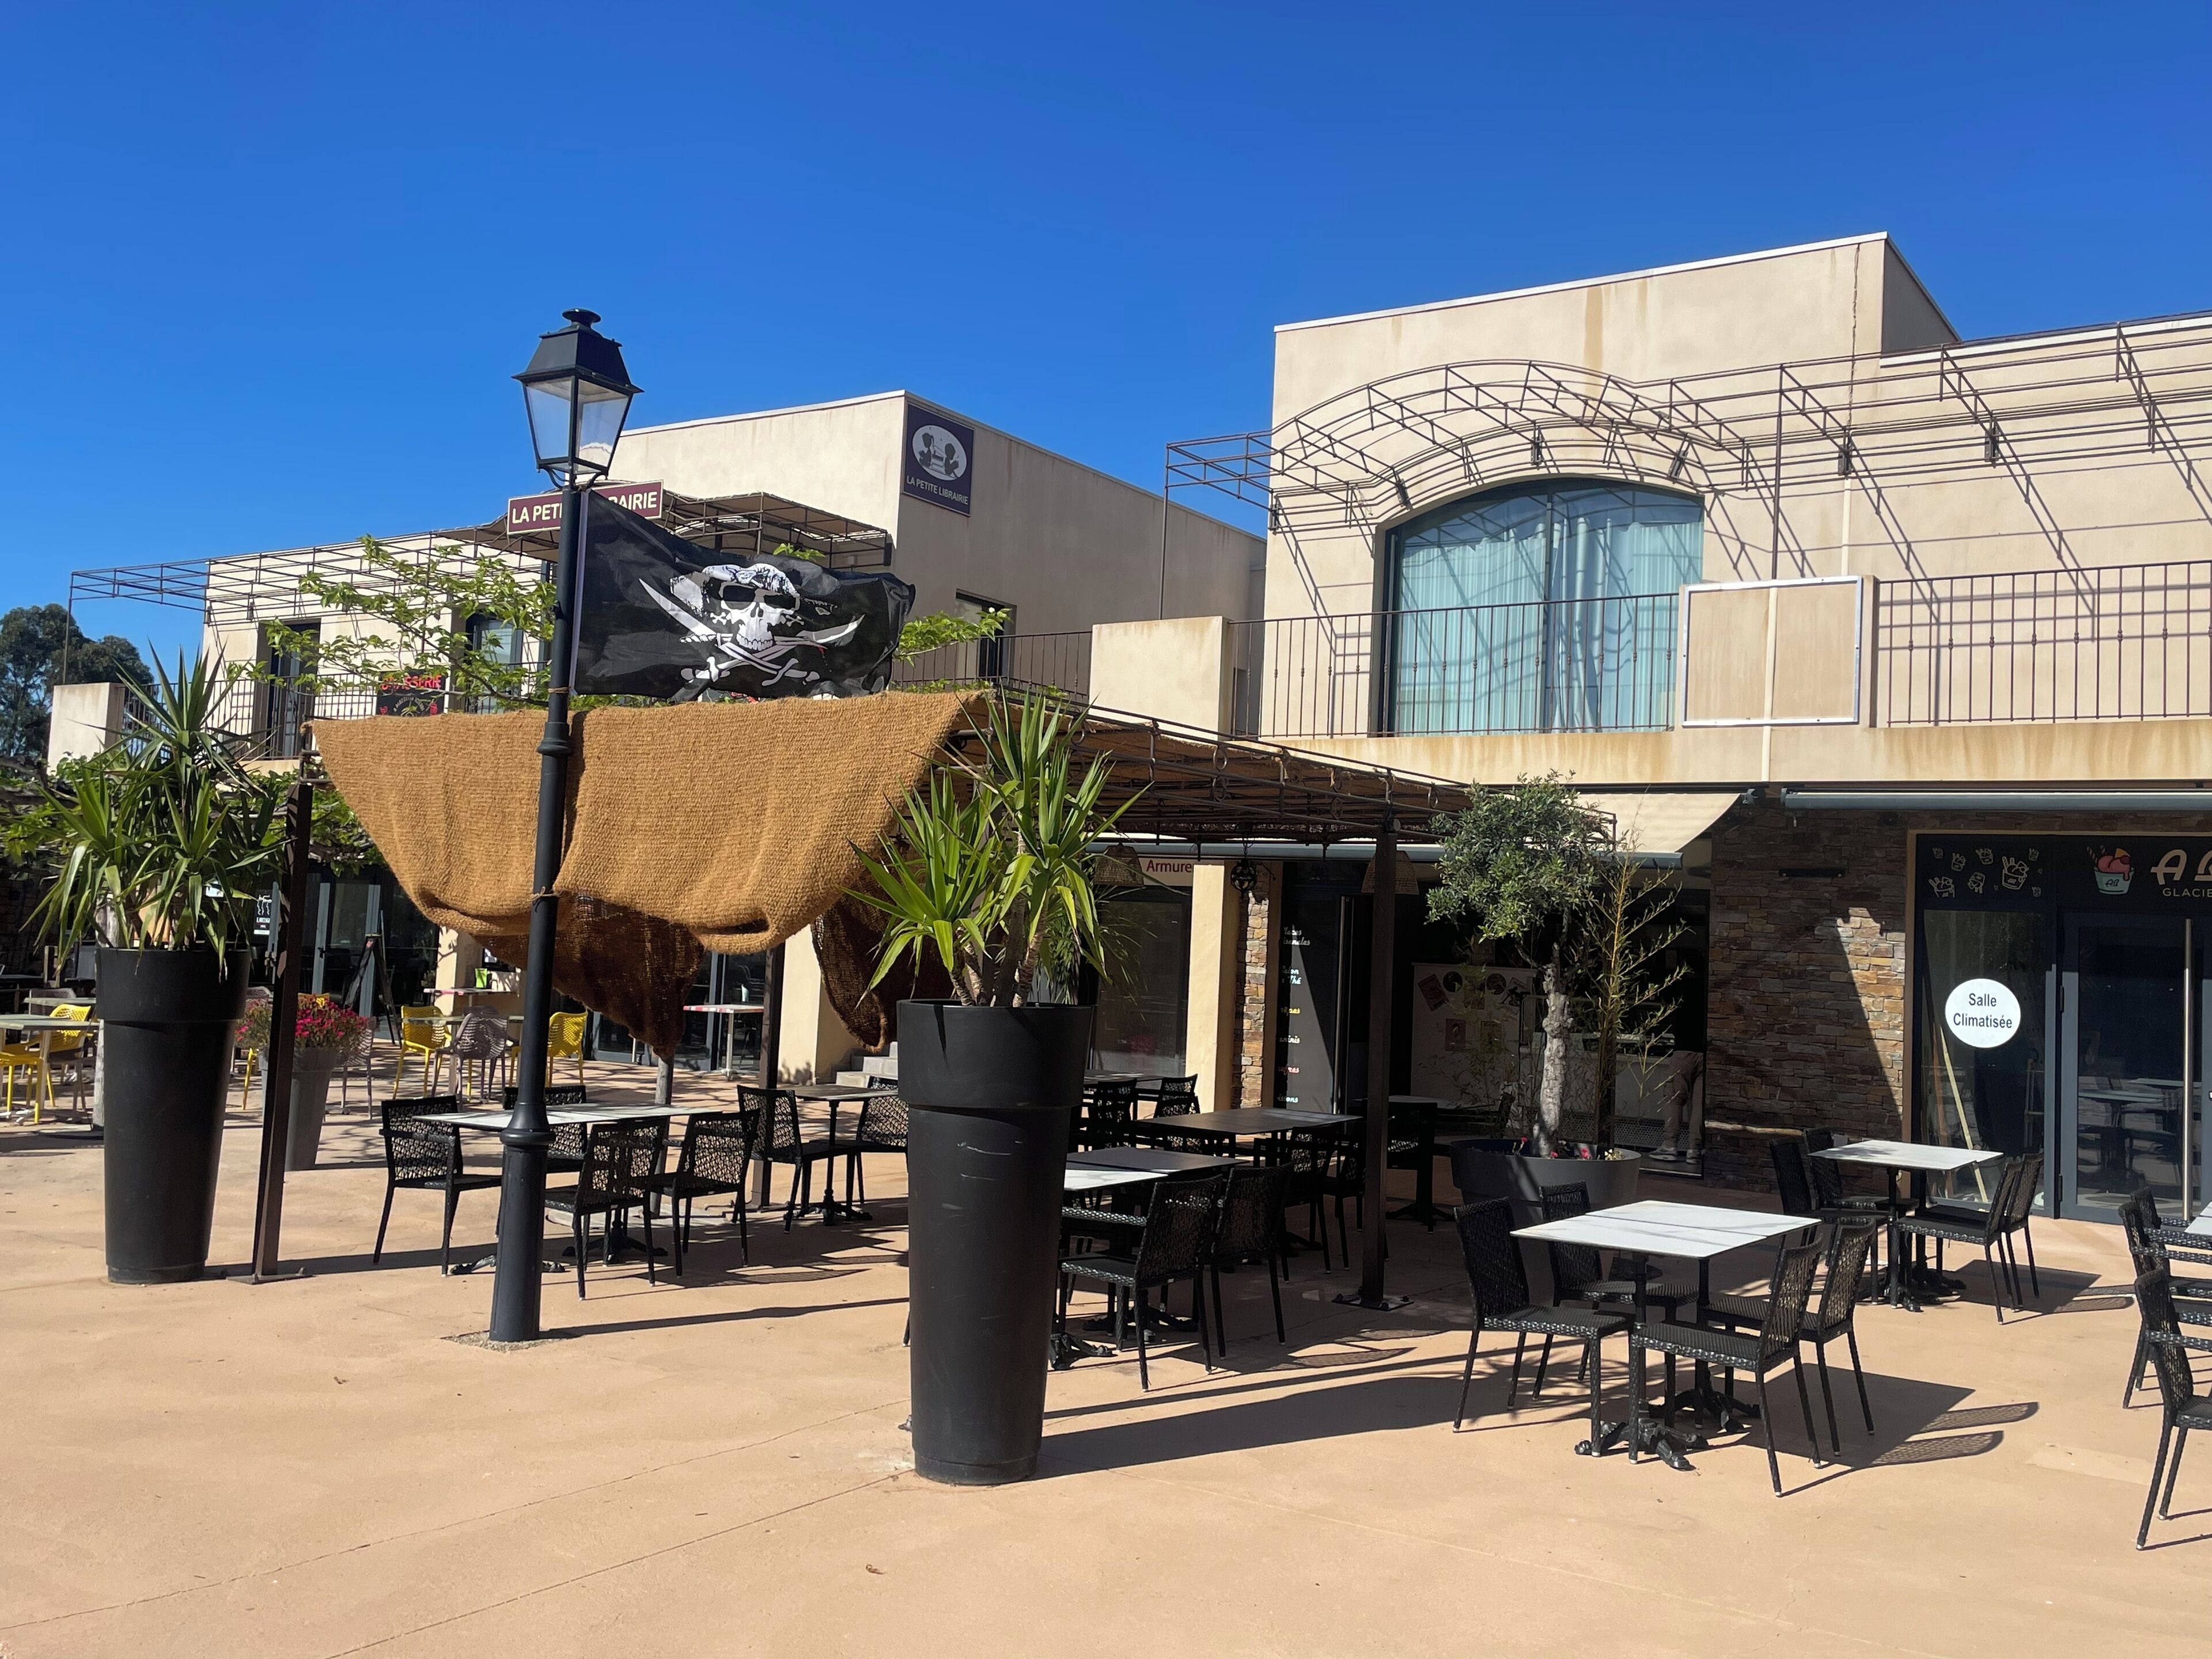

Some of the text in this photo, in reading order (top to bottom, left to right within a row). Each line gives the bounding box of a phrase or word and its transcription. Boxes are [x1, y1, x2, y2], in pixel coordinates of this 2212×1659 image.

[907, 475, 968, 505] LA PETITE LIBRAIRIE
[512, 491, 657, 524] LA PETI AIRIE
[1146, 859, 1194, 873] Armure
[1968, 993, 1997, 1007] Salle
[1953, 1013, 2013, 1028] Climatisée
